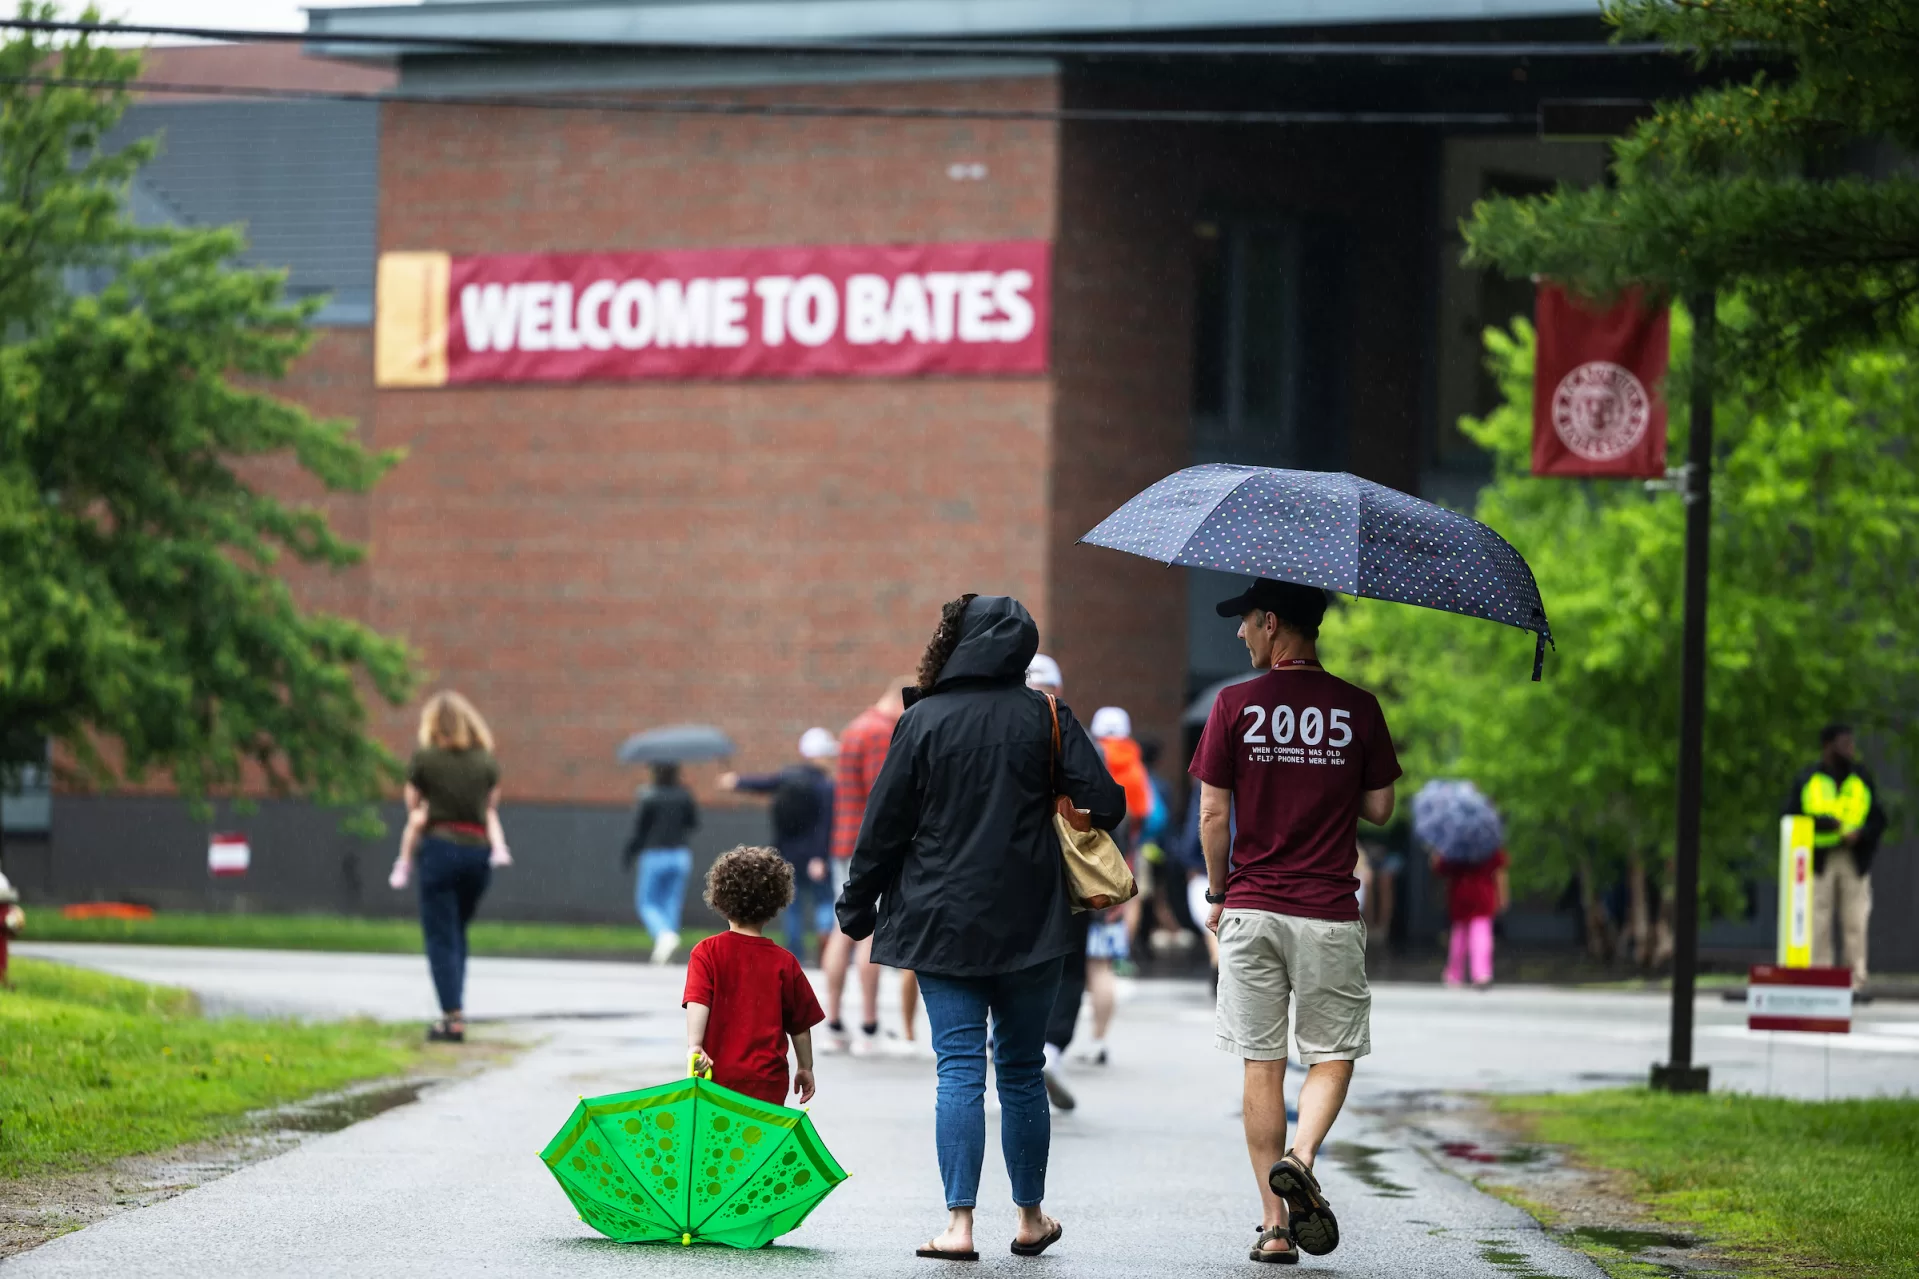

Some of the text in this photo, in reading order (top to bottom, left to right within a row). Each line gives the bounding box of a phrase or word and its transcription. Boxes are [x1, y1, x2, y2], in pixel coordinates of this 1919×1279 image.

[461, 278, 749, 351] WELCOME
[754, 275, 838, 346] TO
[845, 270, 1034, 344] BATES
[1244, 705, 1352, 747] 2005
[1257, 755, 1274, 763] FLIP
[1278, 756, 1305, 764] PHONES
[1274, 747, 1305, 756] COMMONS
